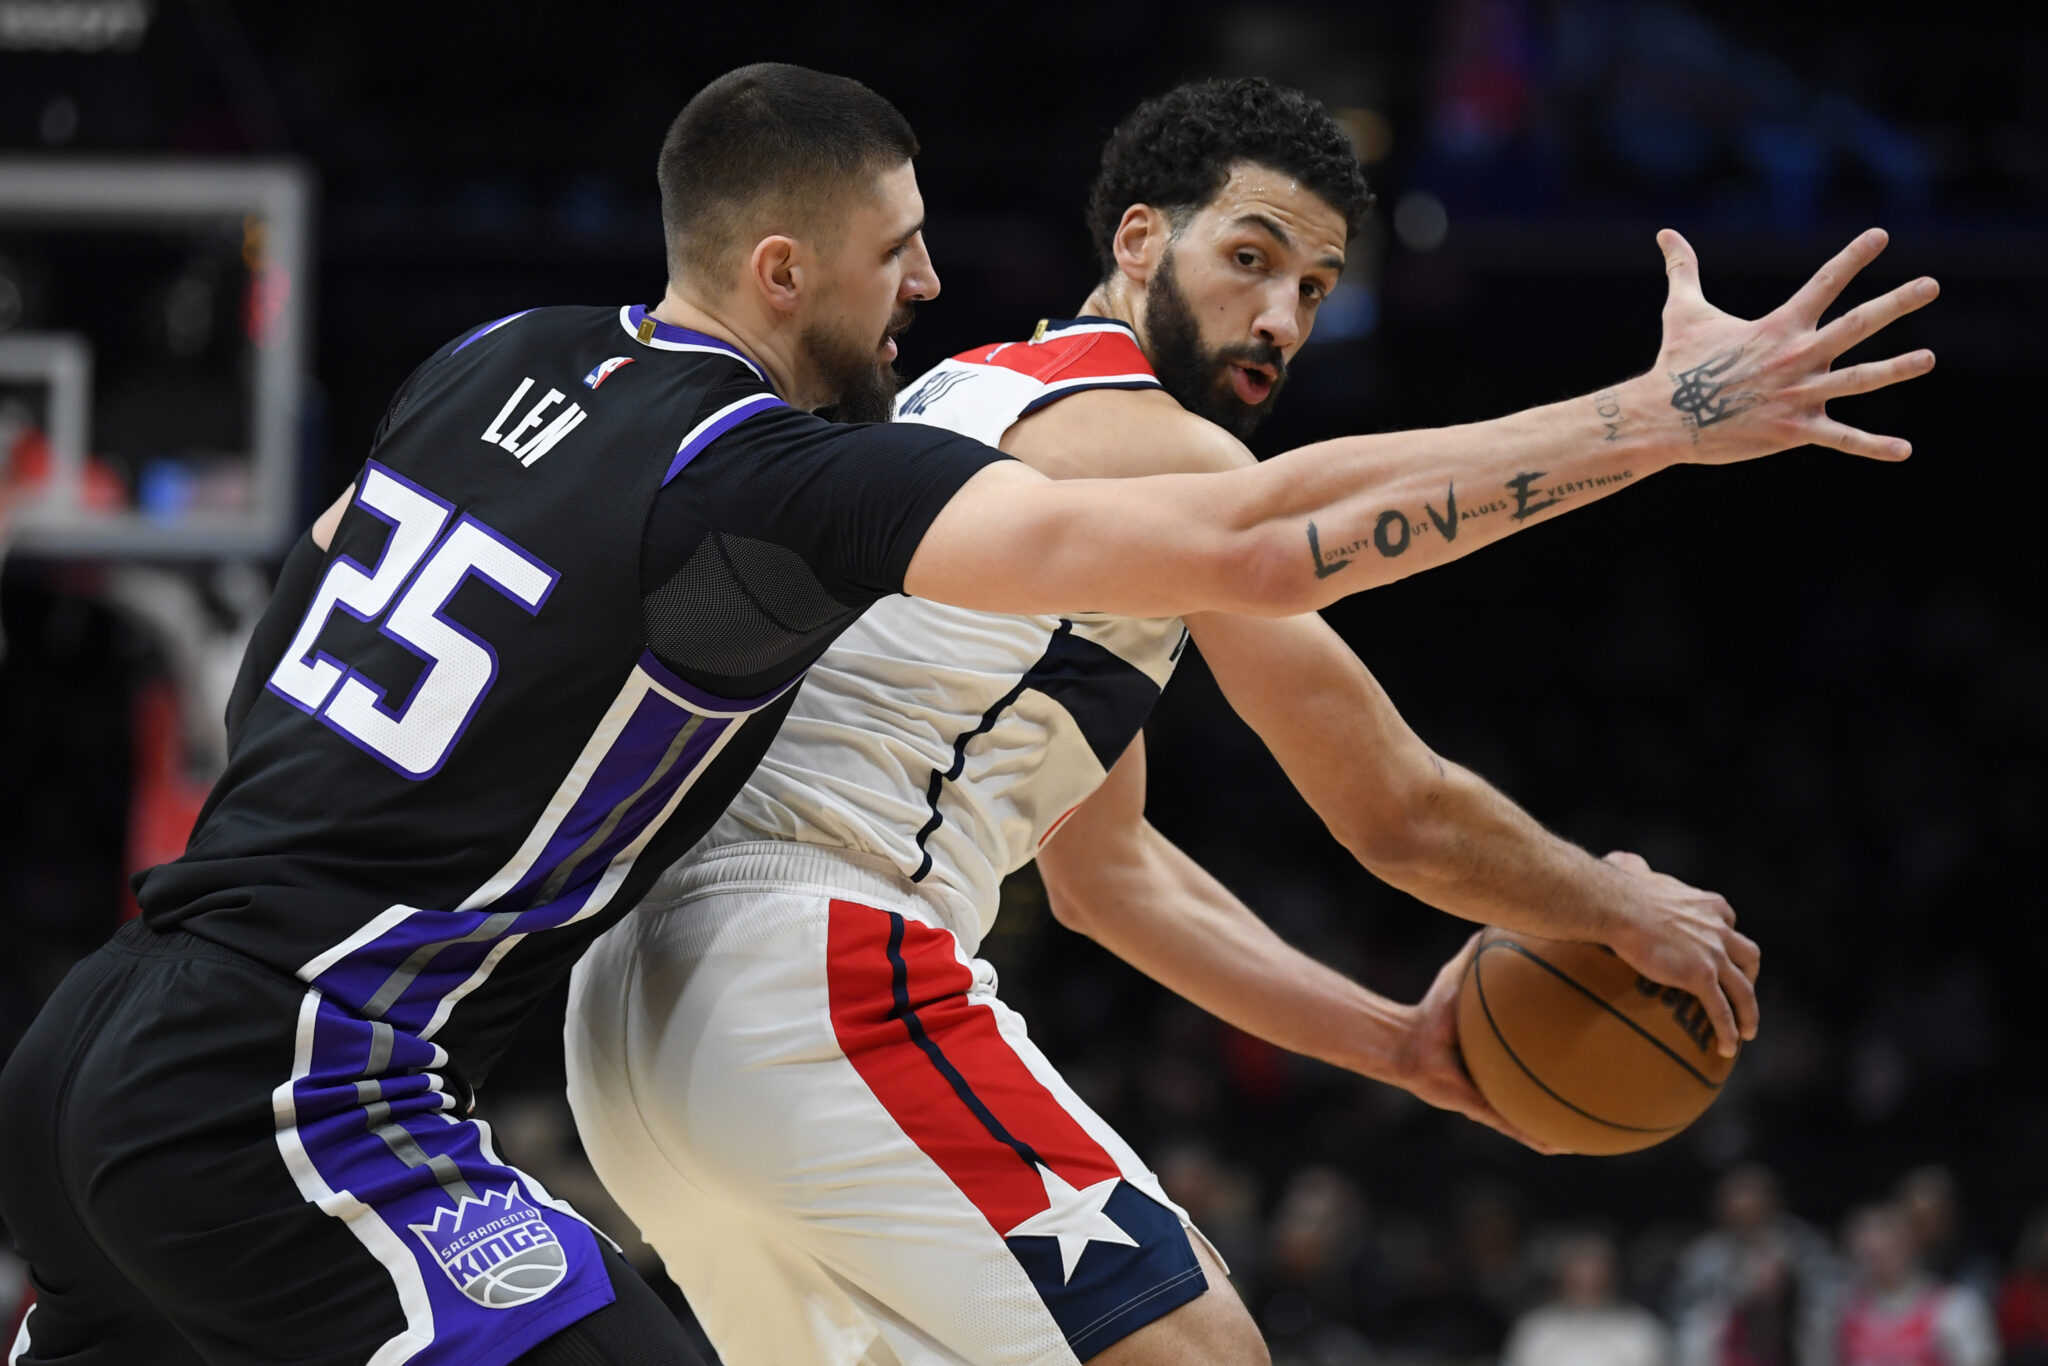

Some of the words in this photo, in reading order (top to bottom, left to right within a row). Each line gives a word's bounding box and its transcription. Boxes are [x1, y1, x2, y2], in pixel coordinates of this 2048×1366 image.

[481, 376, 587, 468] LEN
[265, 458, 562, 781] 25
[441, 1209, 534, 1260] SACRAMENTO
[448, 1222, 556, 1288] KINGS
